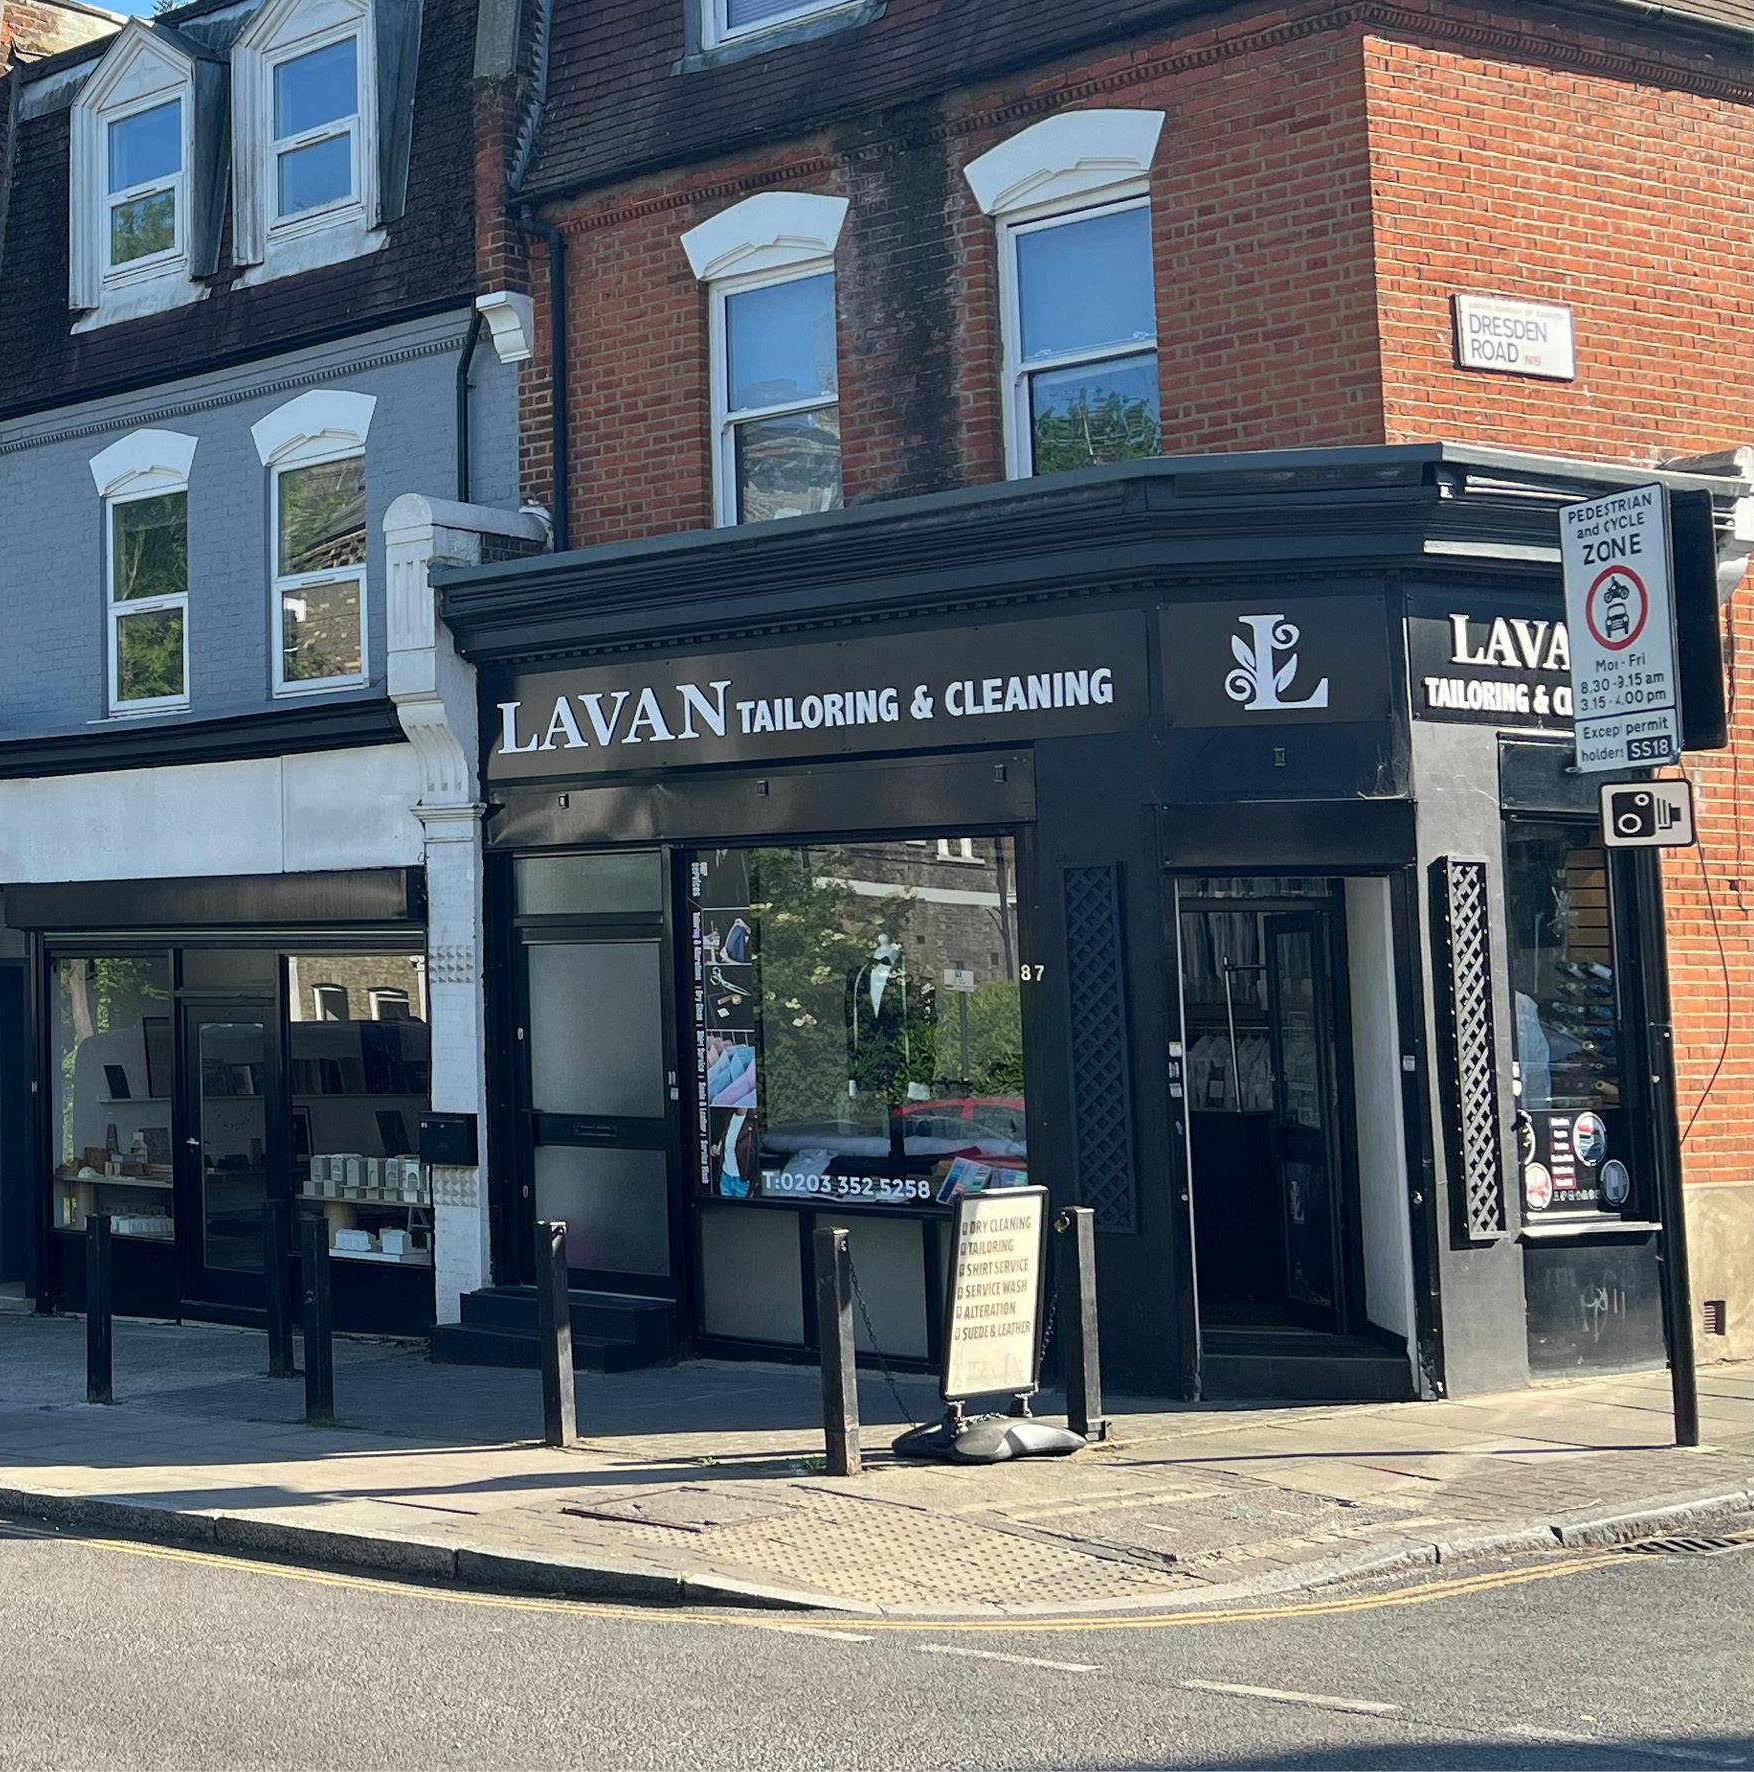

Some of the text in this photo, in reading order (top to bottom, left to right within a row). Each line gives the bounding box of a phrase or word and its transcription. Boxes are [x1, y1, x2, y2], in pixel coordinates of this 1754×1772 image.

[1469, 314, 1548, 342] DRESDEN
[1471, 338, 1519, 362] ROAD
[1568, 492, 1652, 524] PEDESTRIAN
[1577, 512, 1645, 539] and CYCLE
[1582, 532, 1642, 565] ZONE
[1449, 613, 1572, 672] LAVA
[1628, 652, 1646, 667] Fri
[1581, 678, 1610, 694] 8.30
[1646, 672, 1665, 684] am
[1424, 676, 1530, 714] TAILORING
[1534, 684, 1550, 715] &
[1581, 696, 1606, 711] 3.15
[1647, 690, 1667, 704] pm
[496, 667, 1115, 755] LAVAN TAILORING & CLEANING
[1583, 716, 1669, 740] Excep permit
[1631, 739, 1669, 758] SS18
[1020, 964, 1045, 982] 87
[762, 1170, 932, 1199] T:0203 352 5258
[970, 1216, 1032, 1234] DRY CLEANING
[968, 1239, 1014, 1256] TAILORING
[966, 1258, 1029, 1276] SHIRT SERVICE
[965, 1279, 1028, 1298] SERVICE WASH
[964, 1301, 1016, 1320] ALTERATION
[962, 1320, 1031, 1341] SUEDE & LEATHER
